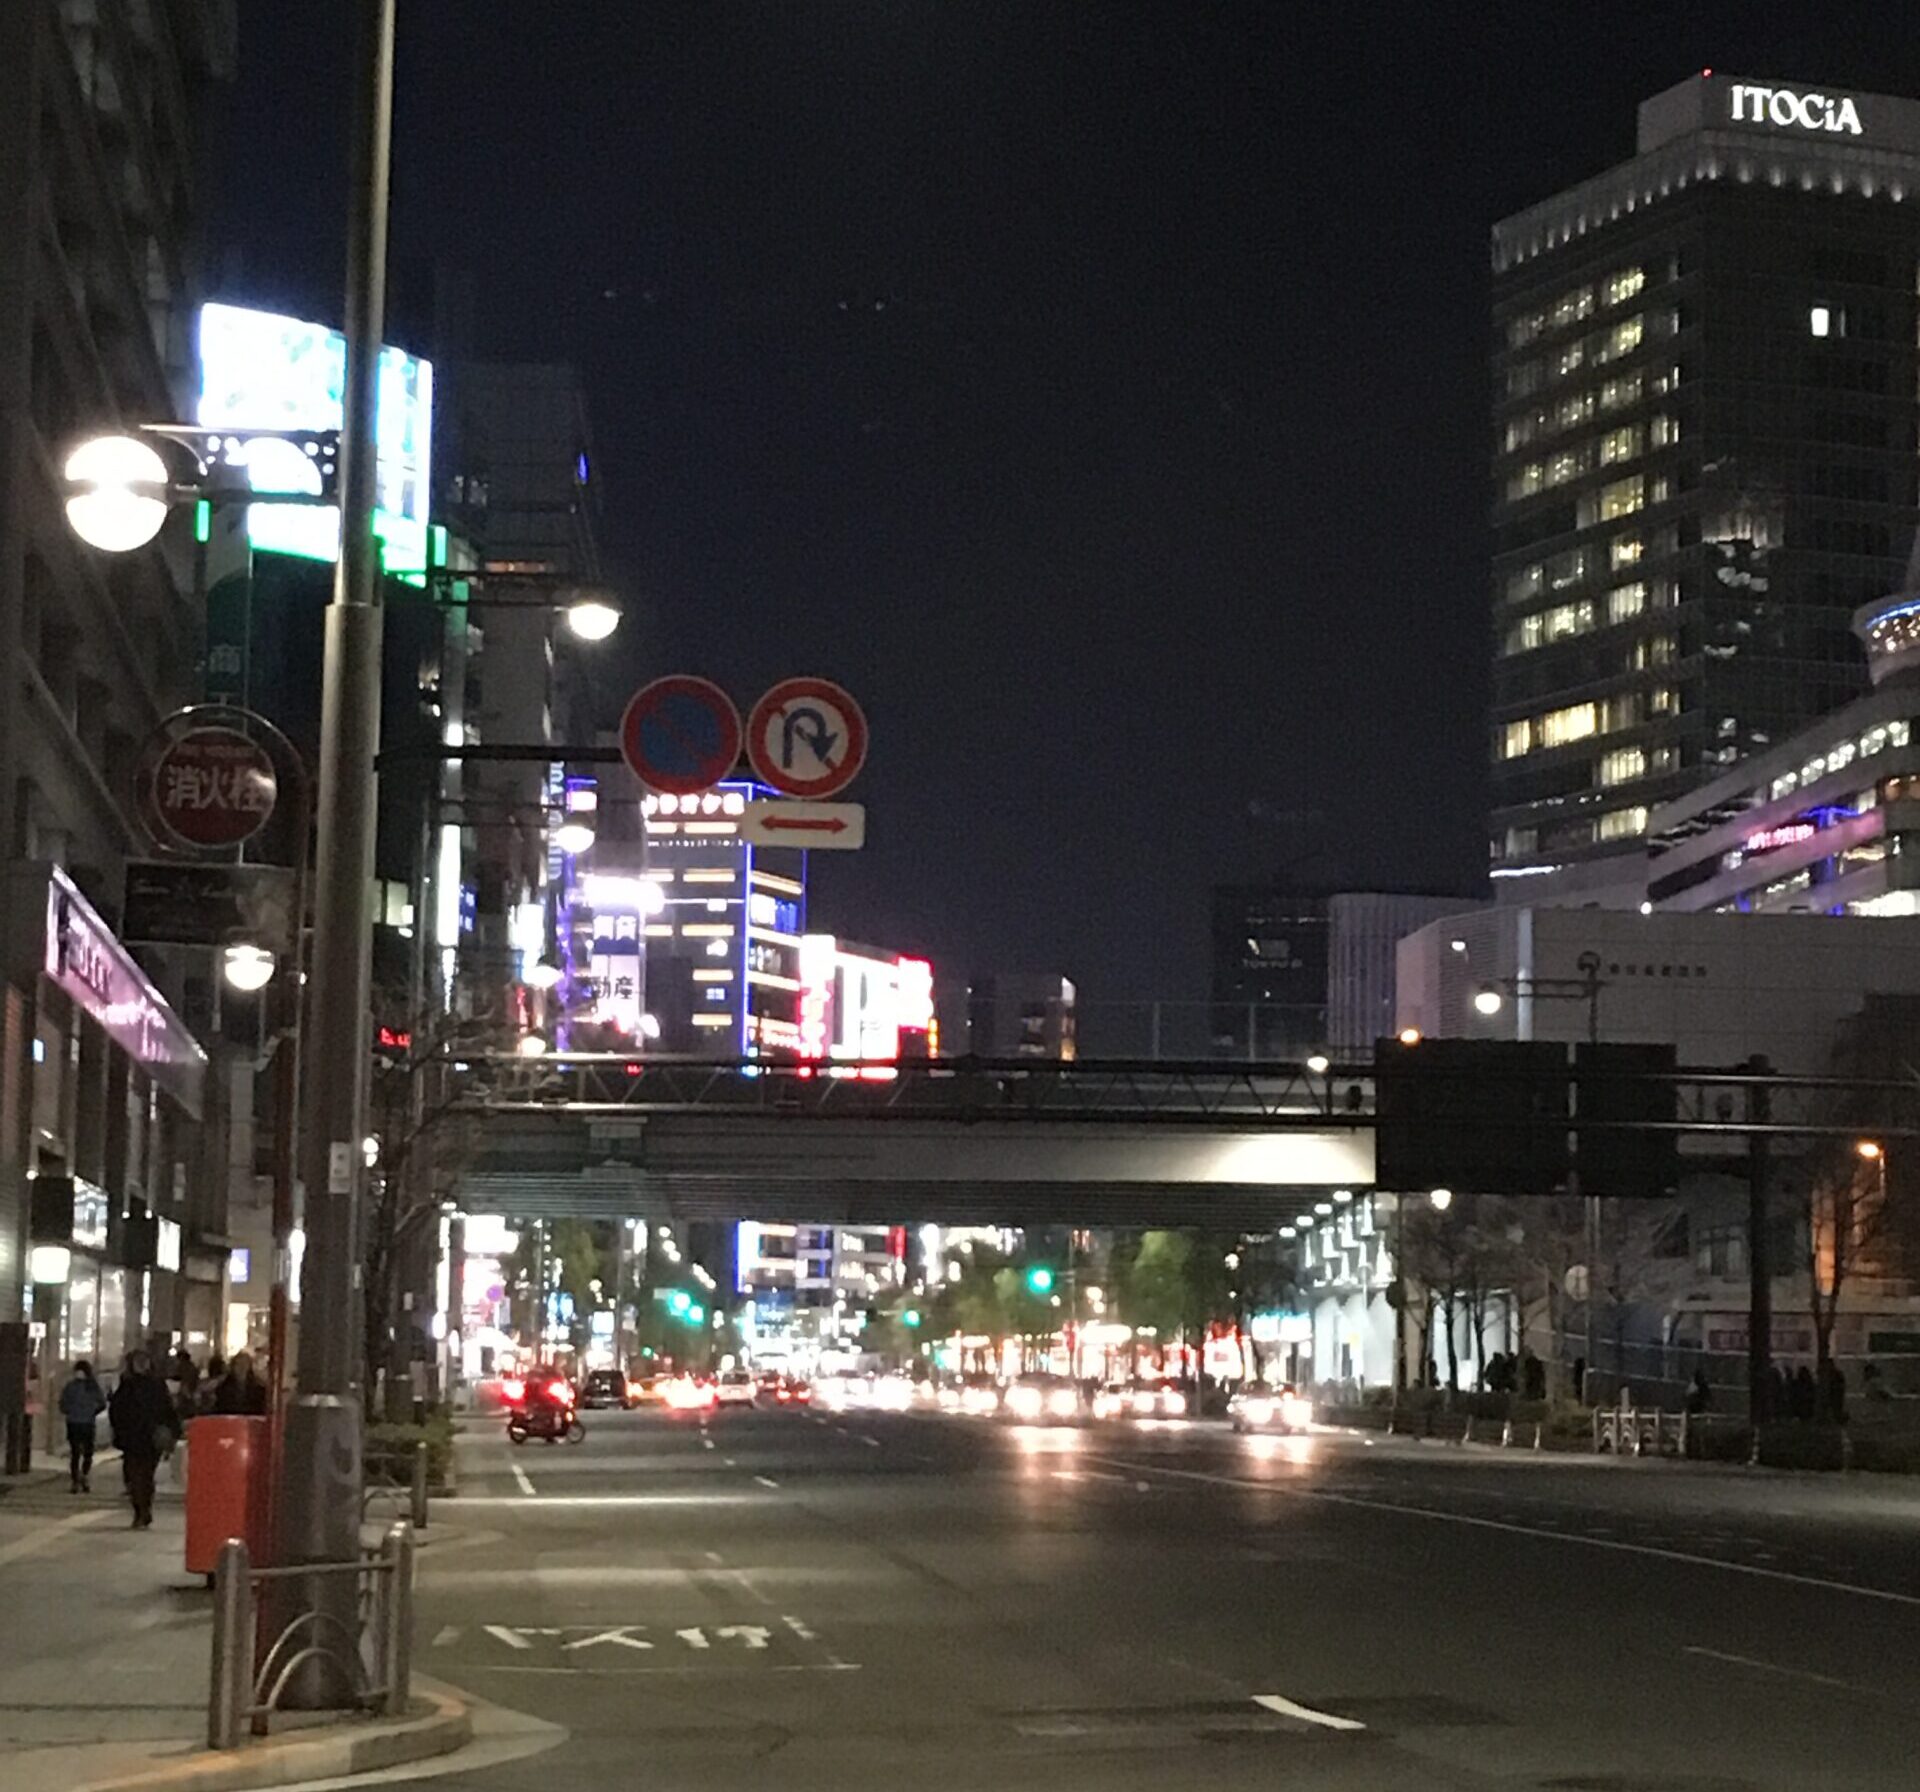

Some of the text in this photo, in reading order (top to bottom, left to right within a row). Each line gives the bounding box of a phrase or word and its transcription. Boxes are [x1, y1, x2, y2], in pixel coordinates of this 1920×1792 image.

[1731, 84, 1863, 135] ITOCiA
[165, 764, 275, 813] 消火栓
